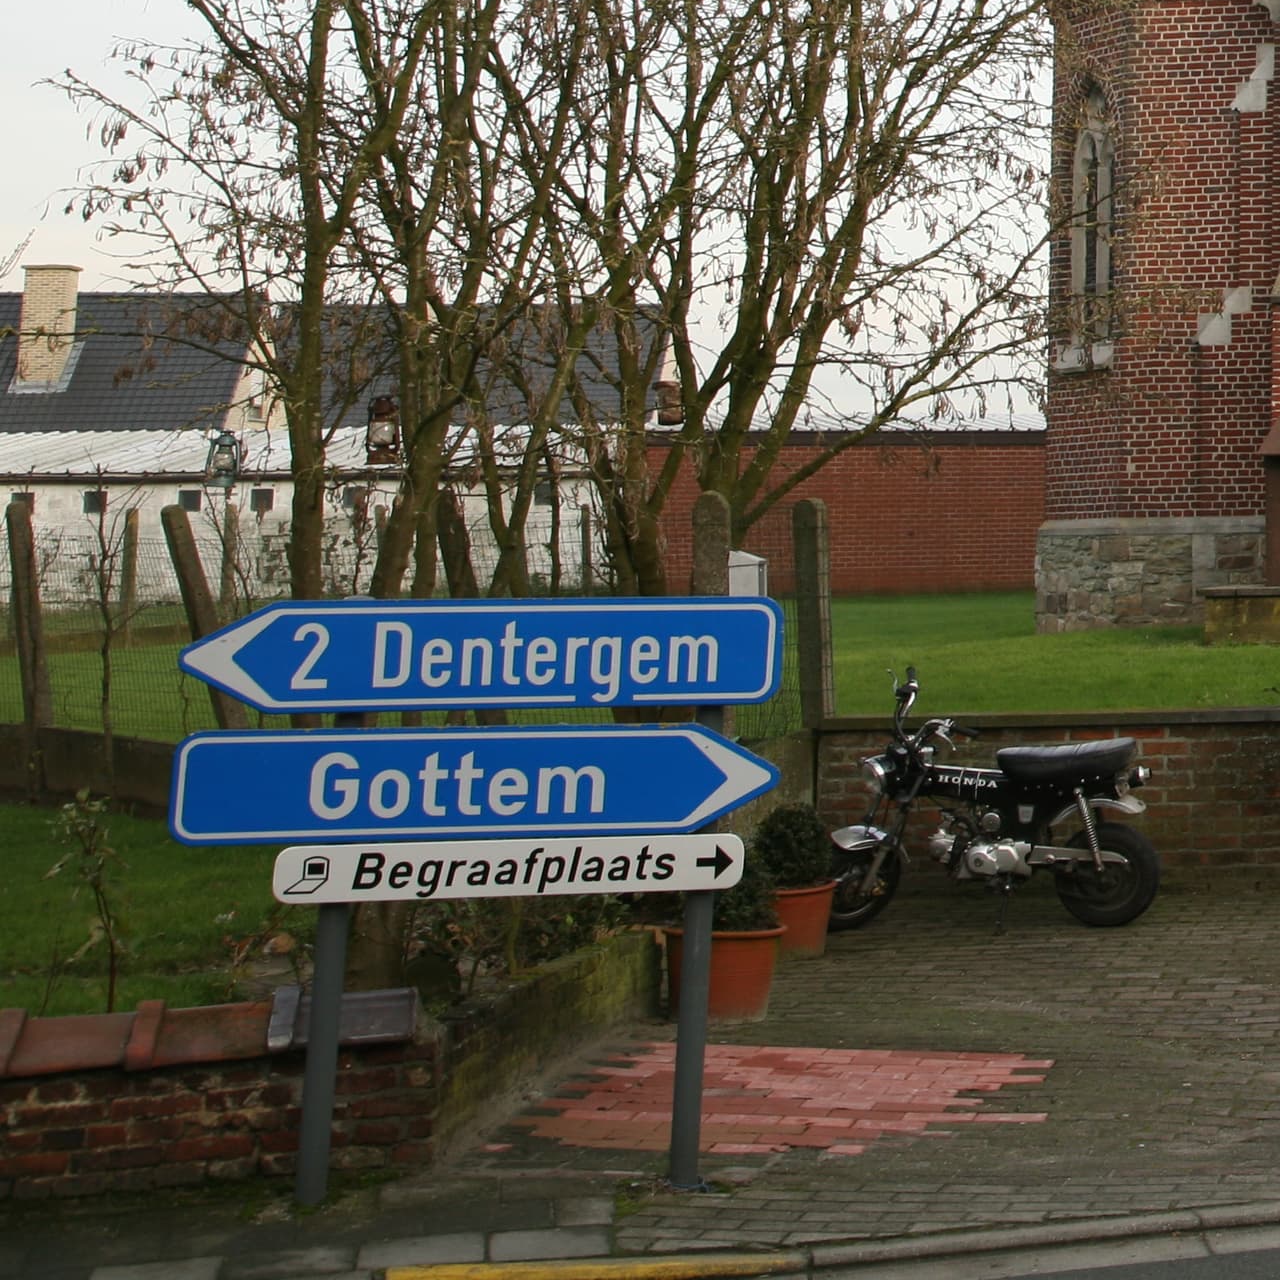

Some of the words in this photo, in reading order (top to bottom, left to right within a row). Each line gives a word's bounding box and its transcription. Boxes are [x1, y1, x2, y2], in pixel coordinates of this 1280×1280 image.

[290, 622, 331, 691] 2
[371, 619, 719, 703] Dentergem
[308, 750, 607, 821] Gottem
[938, 774, 998, 789] HONDA
[351, 846, 676, 897] Begraafplaats
